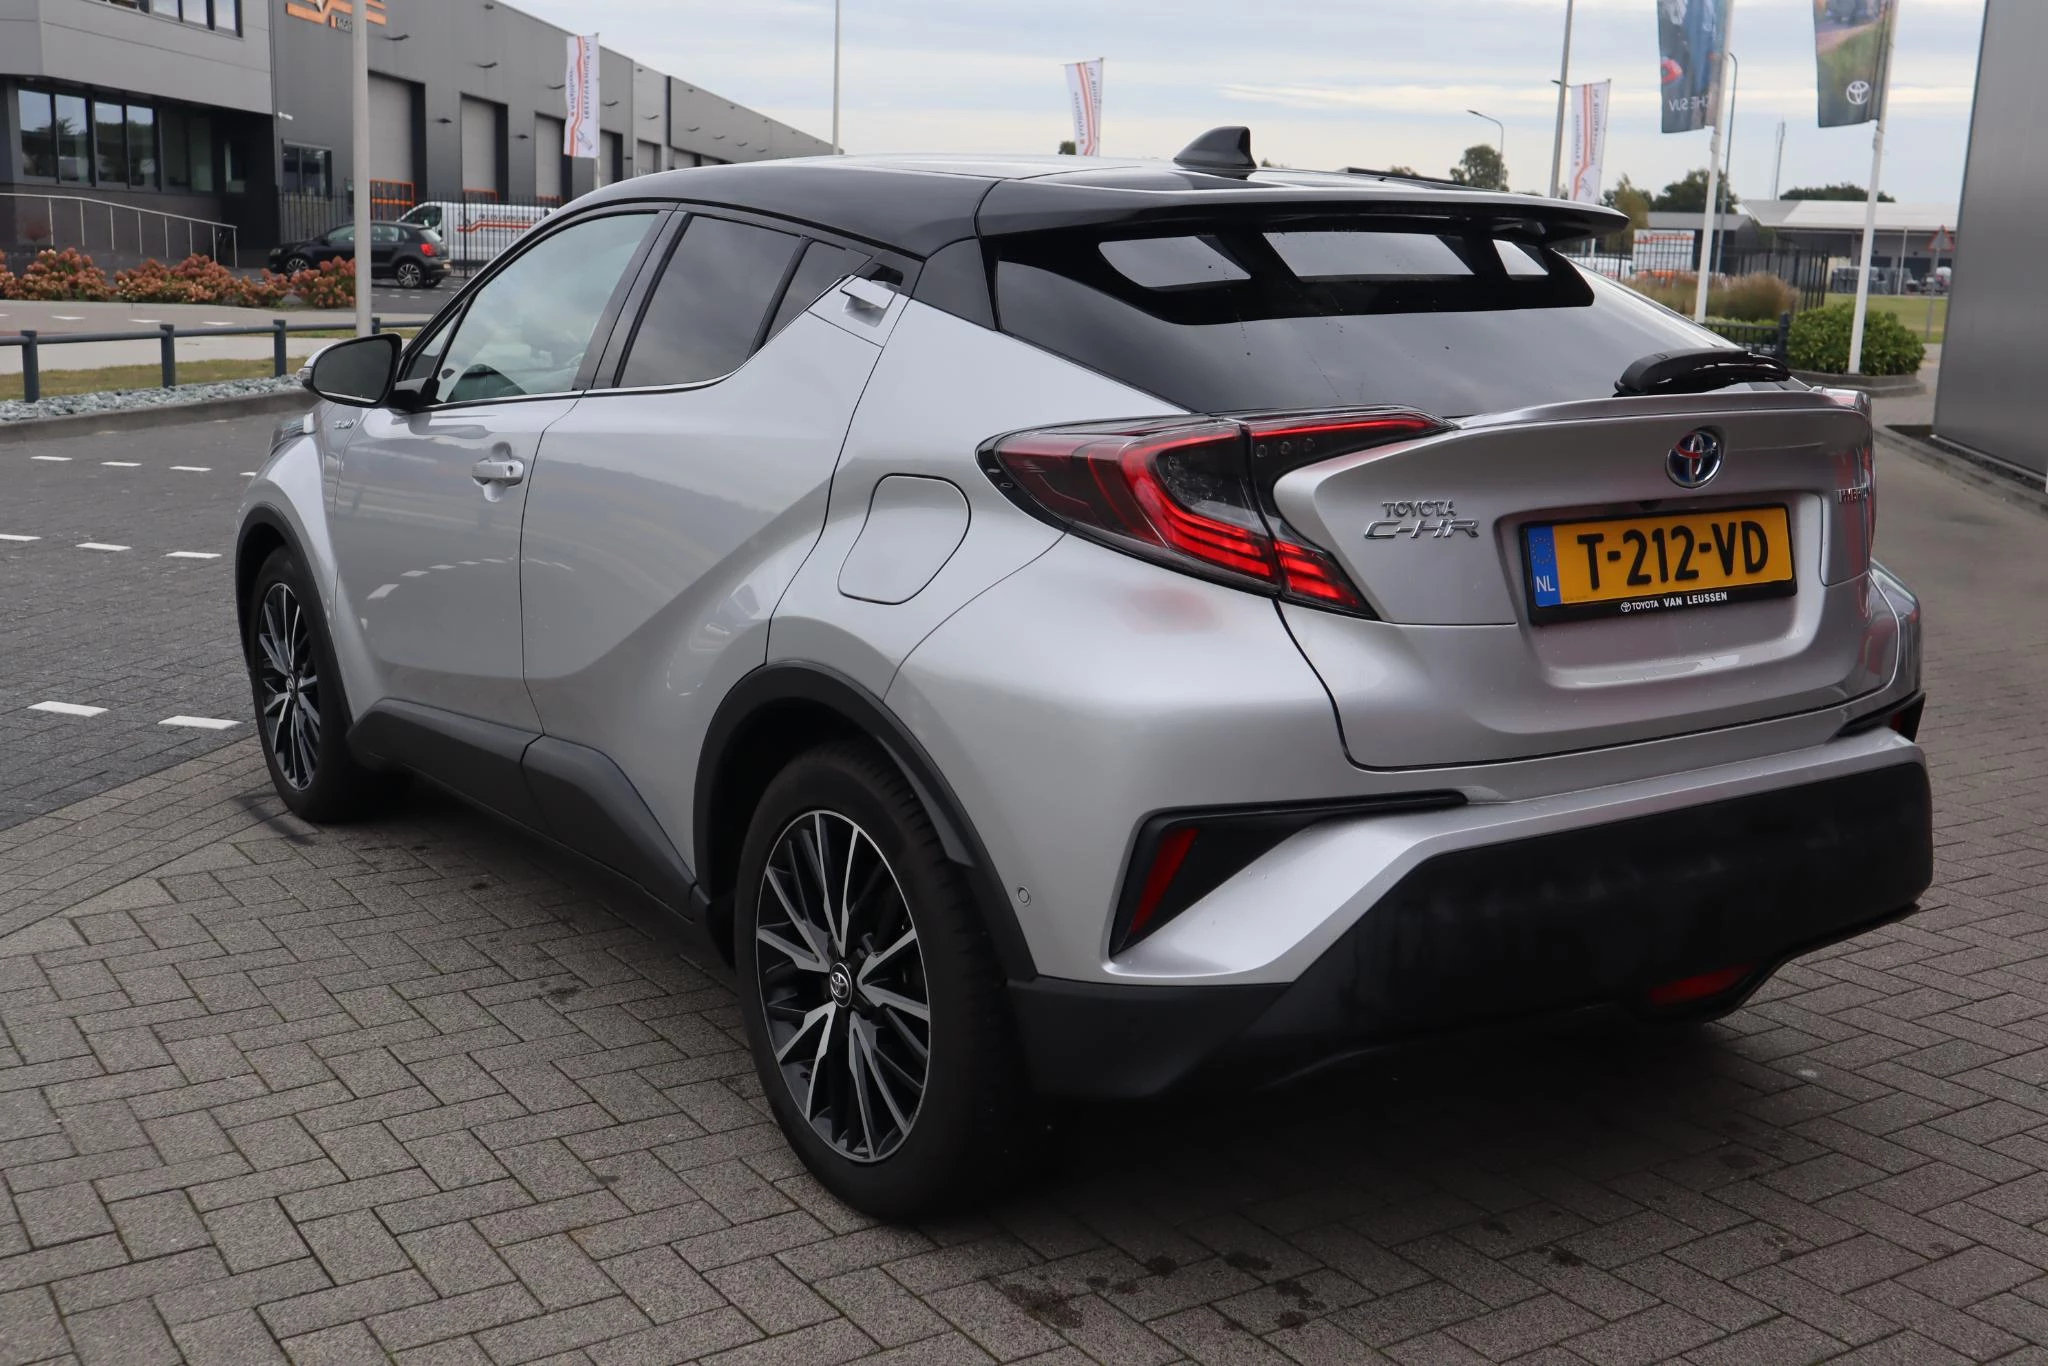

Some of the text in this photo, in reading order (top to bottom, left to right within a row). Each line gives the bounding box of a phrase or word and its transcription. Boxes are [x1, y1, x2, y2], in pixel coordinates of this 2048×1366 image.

[1382, 500, 1457, 518] TOYOTA
[1364, 519, 1480, 539] C-HR
[1577, 521, 1769, 590] T-212-VD
[1536, 575, 1556, 593] NL
[1632, 591, 1728, 610] TOYOTA VAN LEUSSEN
